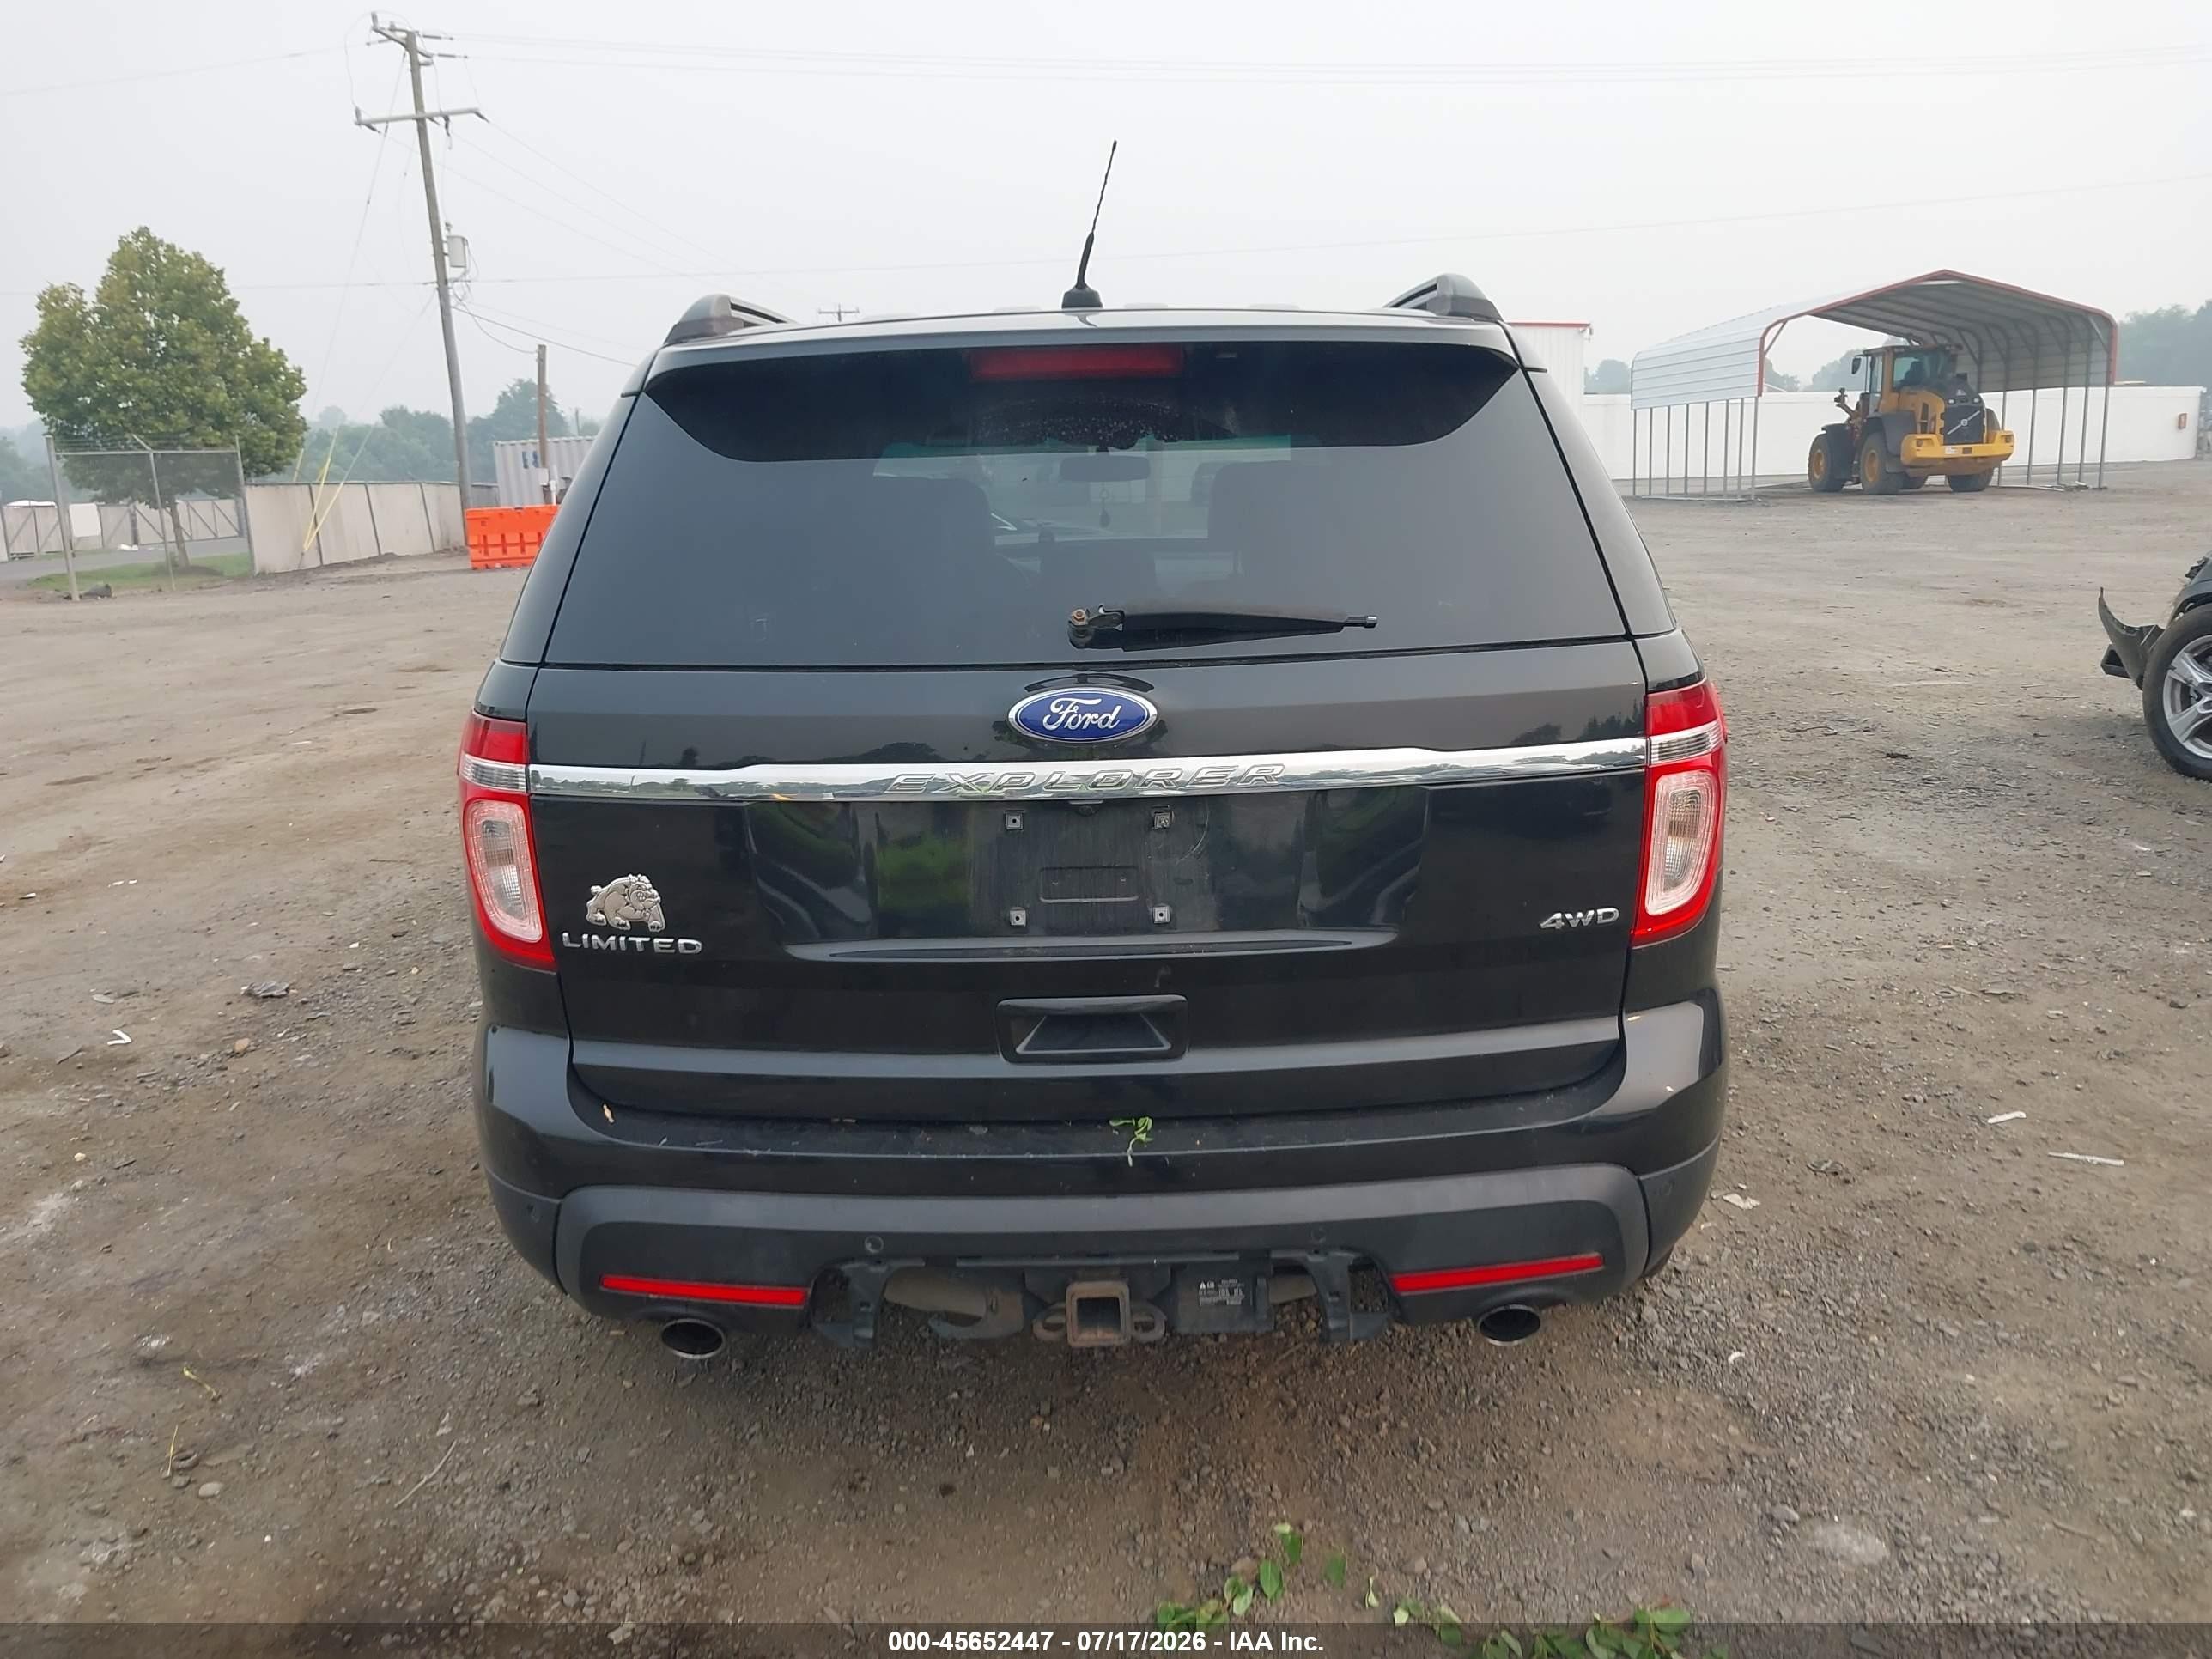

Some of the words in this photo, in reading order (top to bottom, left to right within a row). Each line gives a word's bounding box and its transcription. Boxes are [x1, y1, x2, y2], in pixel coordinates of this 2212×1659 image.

[1042, 697, 1122, 731] Ford
[884, 763, 1285, 794] EXPLORER
[1540, 907, 1620, 929] 4WD
[562, 932, 703, 954] LIMITED
